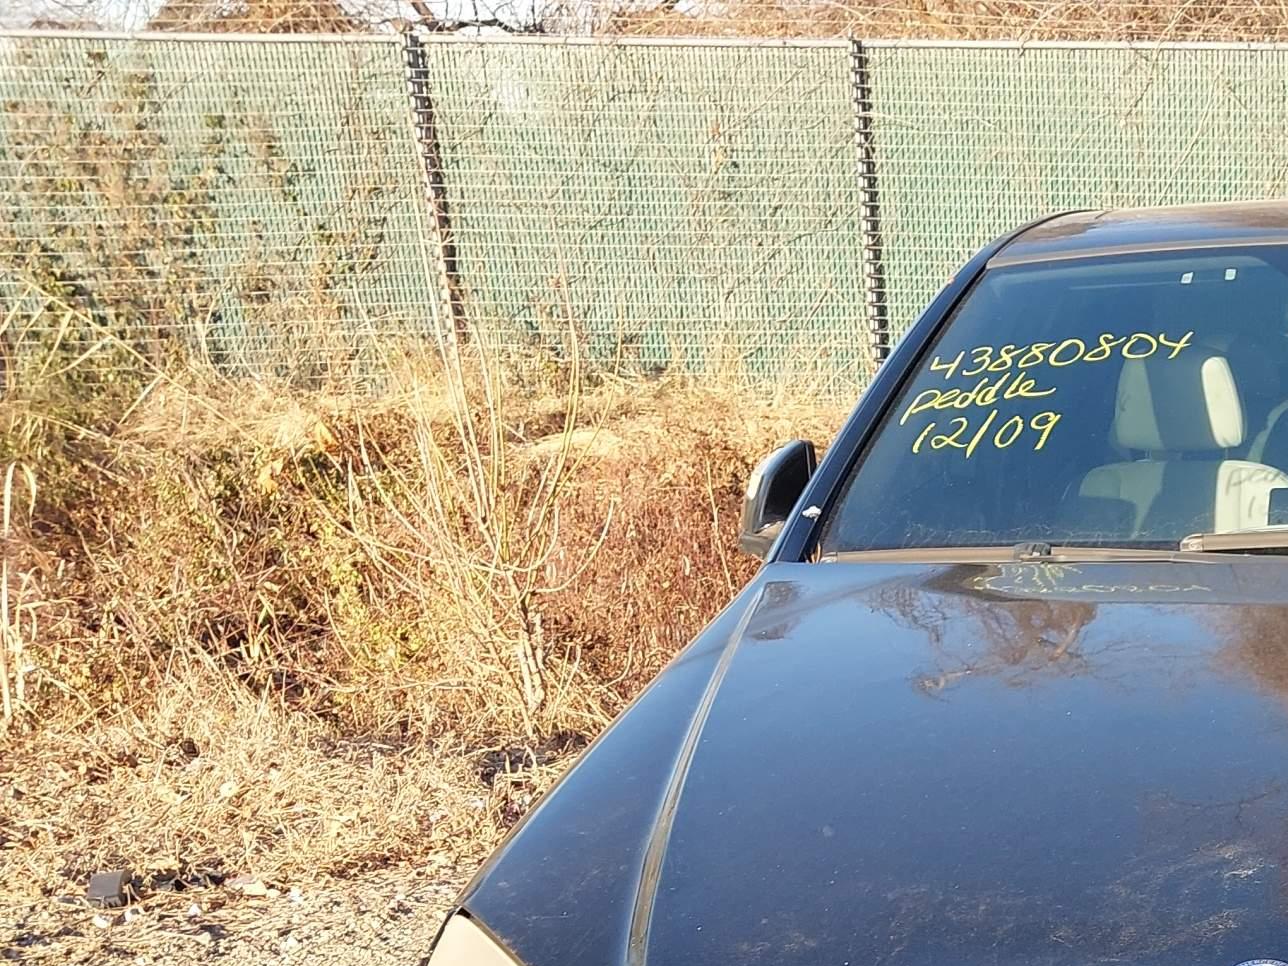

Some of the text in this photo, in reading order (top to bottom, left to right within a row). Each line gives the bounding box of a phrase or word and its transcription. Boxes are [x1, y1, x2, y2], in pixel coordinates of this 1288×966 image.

[930, 331, 1193, 380] 43880804
[899, 371, 1057, 426] peddle
[911, 411, 1061, 459] 12/09
